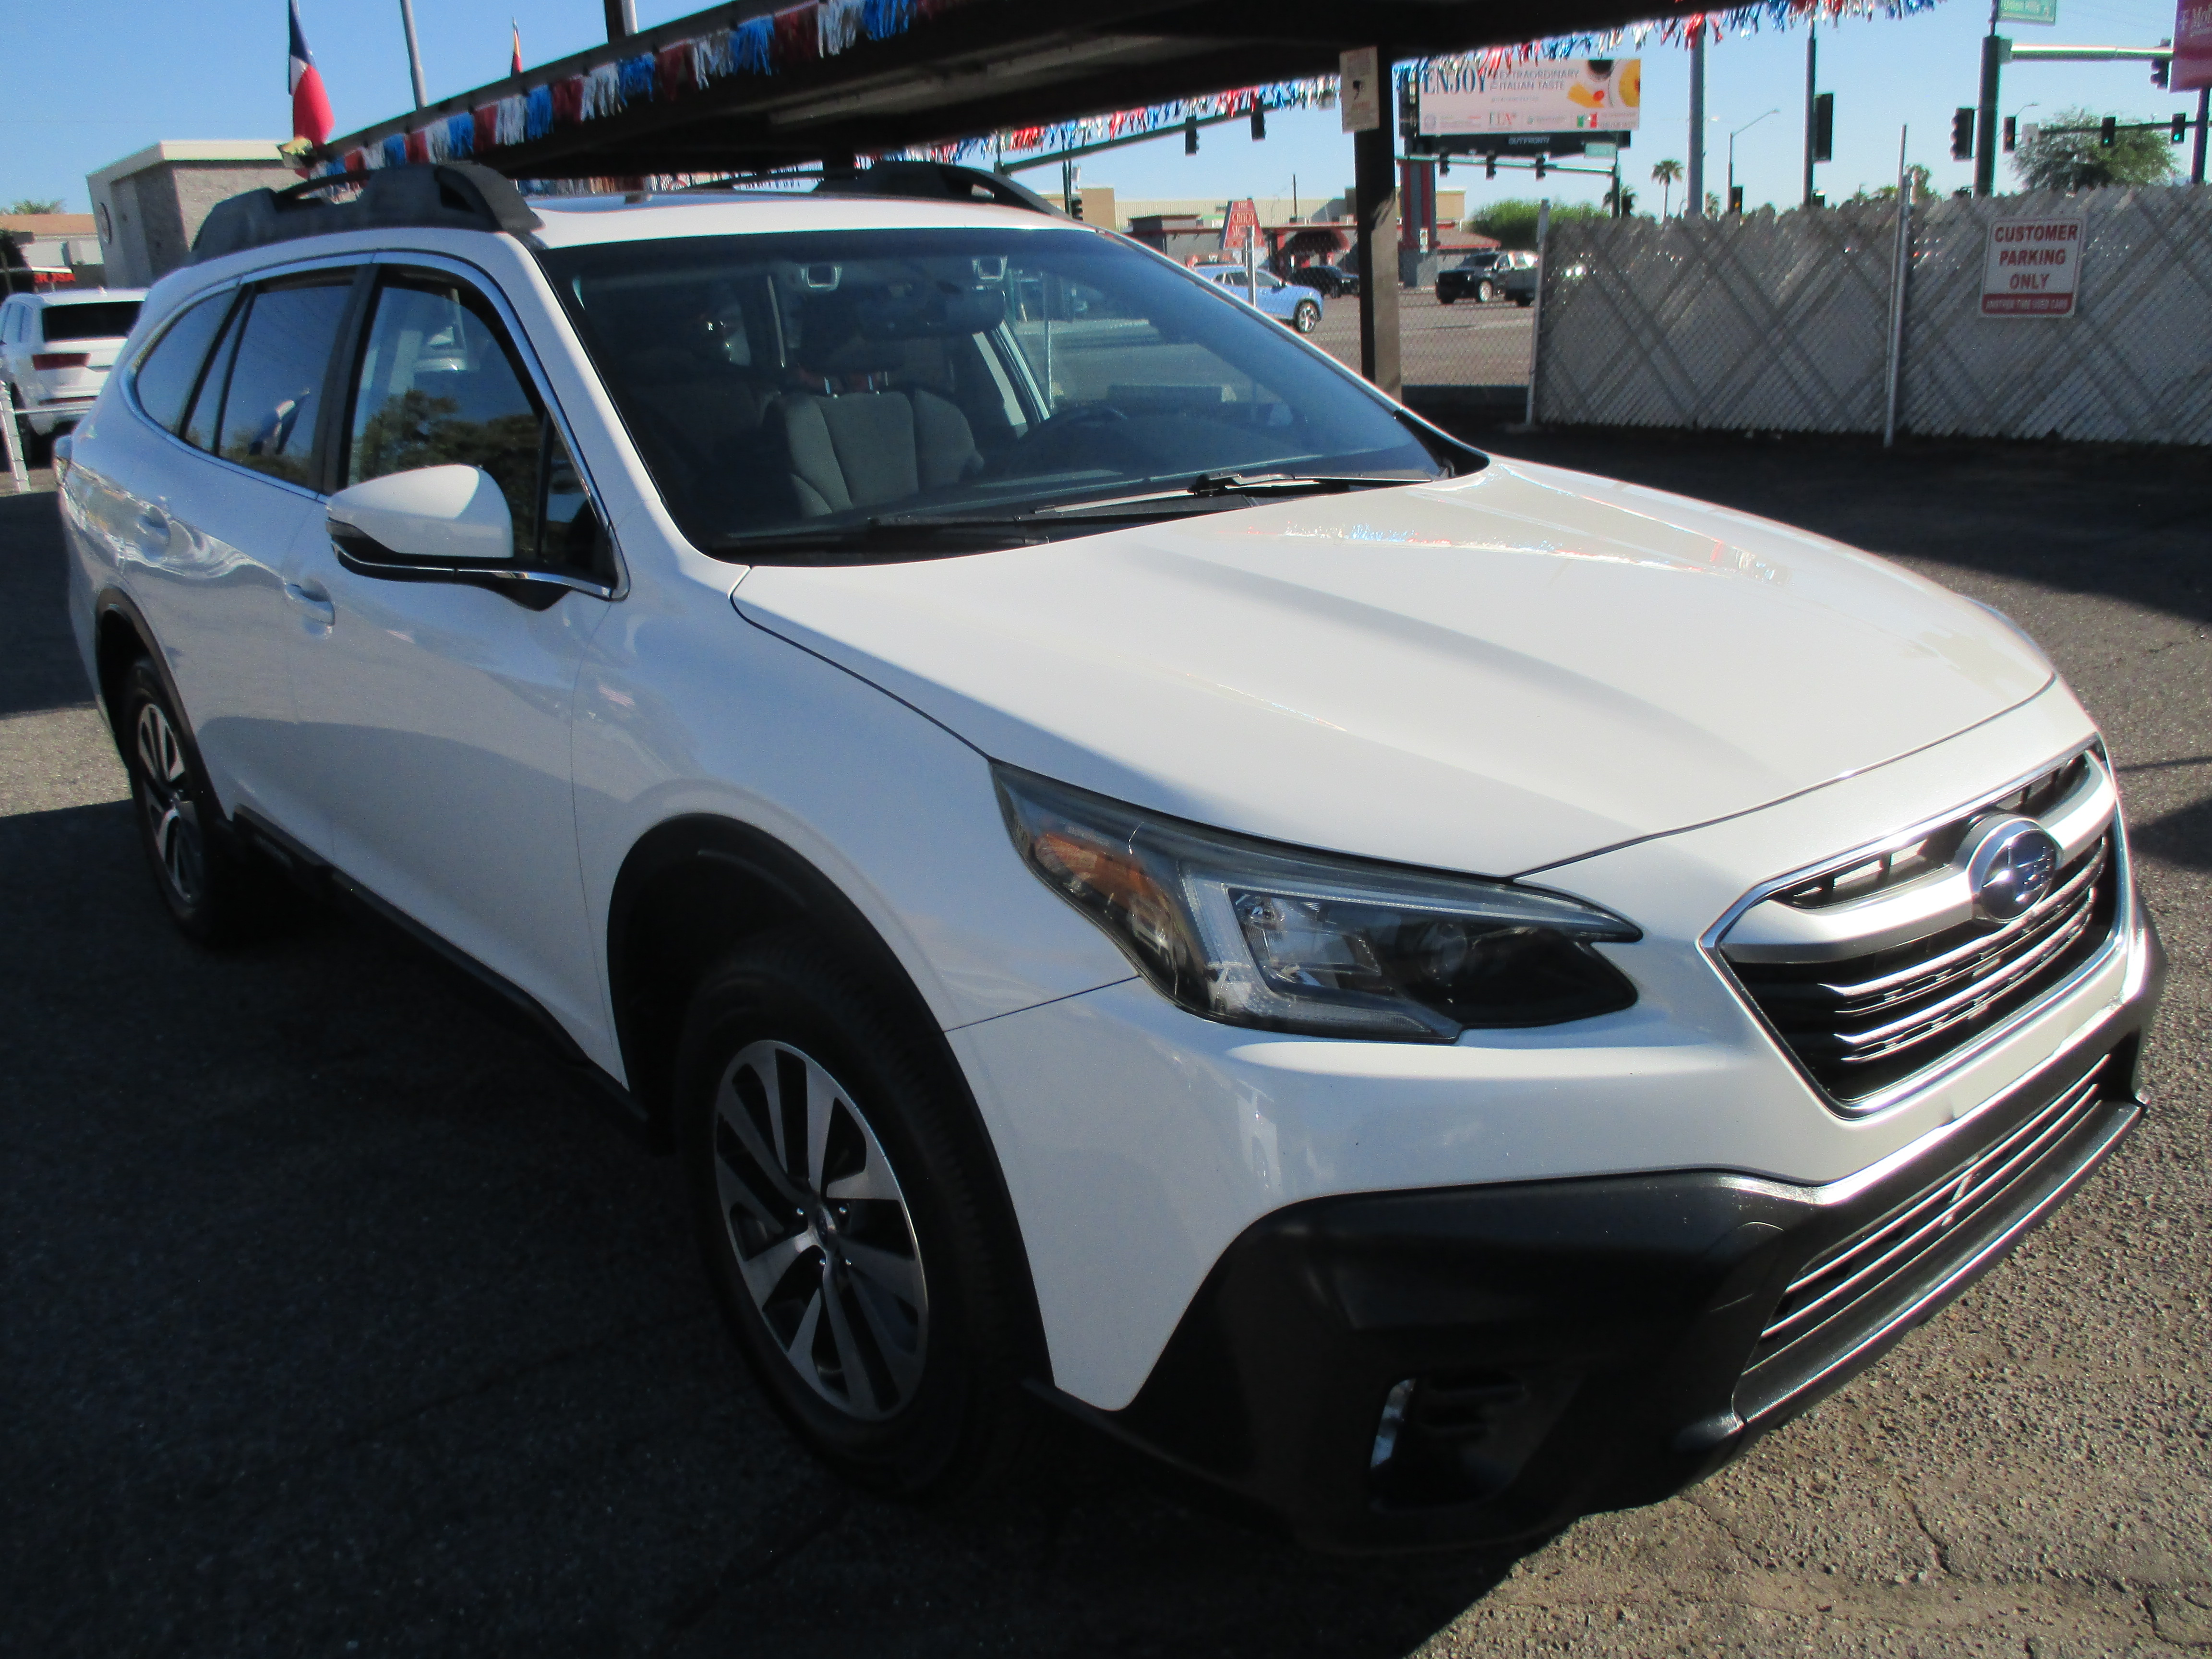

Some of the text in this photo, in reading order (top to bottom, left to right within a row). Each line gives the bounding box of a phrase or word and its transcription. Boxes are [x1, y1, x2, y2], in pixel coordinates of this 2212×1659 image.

[1423, 67, 1488, 94] ENJOY
[1500, 80, 1564, 90] ITALIAN TASTE
[1995, 224, 2078, 242] CUSTOMER
[1999, 249, 2066, 266] PARKING
[2009, 274, 2050, 289] ONLY
